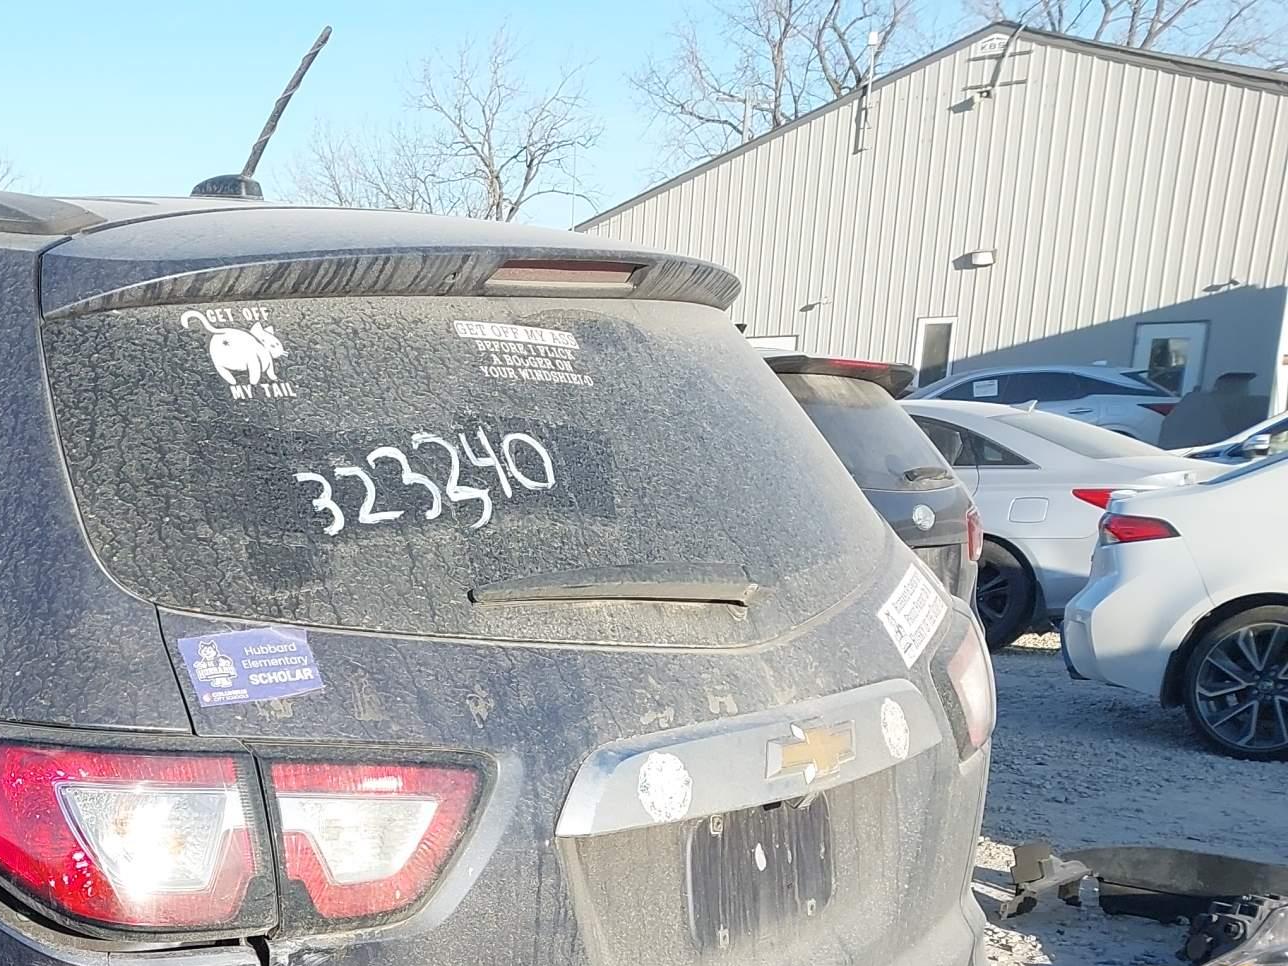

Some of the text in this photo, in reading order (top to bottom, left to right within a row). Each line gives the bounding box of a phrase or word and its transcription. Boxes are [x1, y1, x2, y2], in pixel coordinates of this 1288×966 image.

[206, 307, 269, 323] GET OFF
[455, 322, 578, 347] GET OFF MY ASS
[475, 339, 576, 360] BEFORE I FLICK
[491, 354, 502, 365] A
[555, 360, 574, 372] ON
[479, 365, 518, 380] YOUR
[230, 382, 297, 399] MY TAIL
[244, 642, 297, 656] Hubbard
[241, 655, 309, 669] Elementary
[248, 668, 314, 685] SCHOLAR
